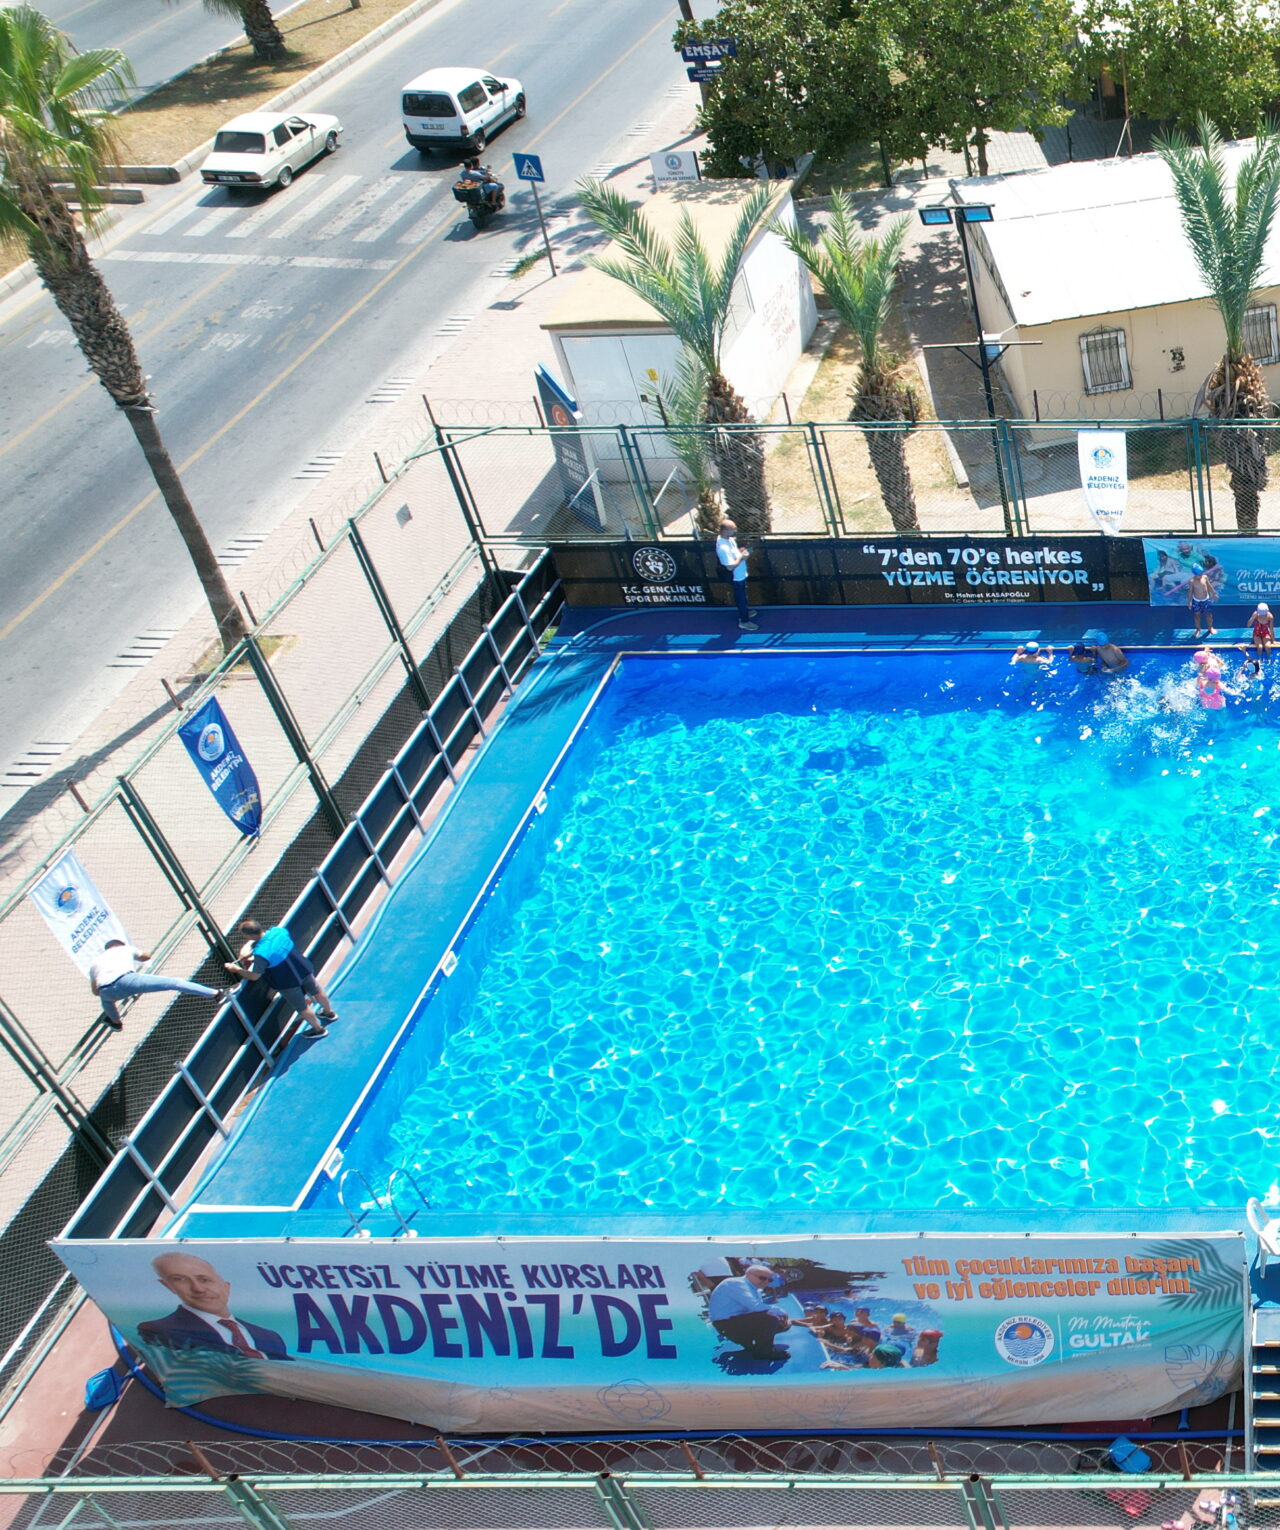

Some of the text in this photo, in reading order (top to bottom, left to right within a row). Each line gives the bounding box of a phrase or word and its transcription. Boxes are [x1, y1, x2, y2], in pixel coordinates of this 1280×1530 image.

[1006, 547, 1083, 565] herkes
[882, 568, 956, 586] YÜZME
[622, 585, 703, 595] T.C. GENÇLİK VE
[625, 594, 706, 603] SPOR BAKANLIĞI
[71, 906, 100, 941] AKDENİZ
[72, 909, 110, 954] BELEDİYESİ
[404, 1261, 515, 1288] YÜZME
[521, 1263, 666, 1289] KURSLARI
[902, 1255, 1200, 1281] Tüm çocuklarımıza başarı
[913, 1281, 941, 1299] ve
[978, 1277, 1102, 1300] eğlenceler
[1107, 1276, 1197, 1297] dilerim.
